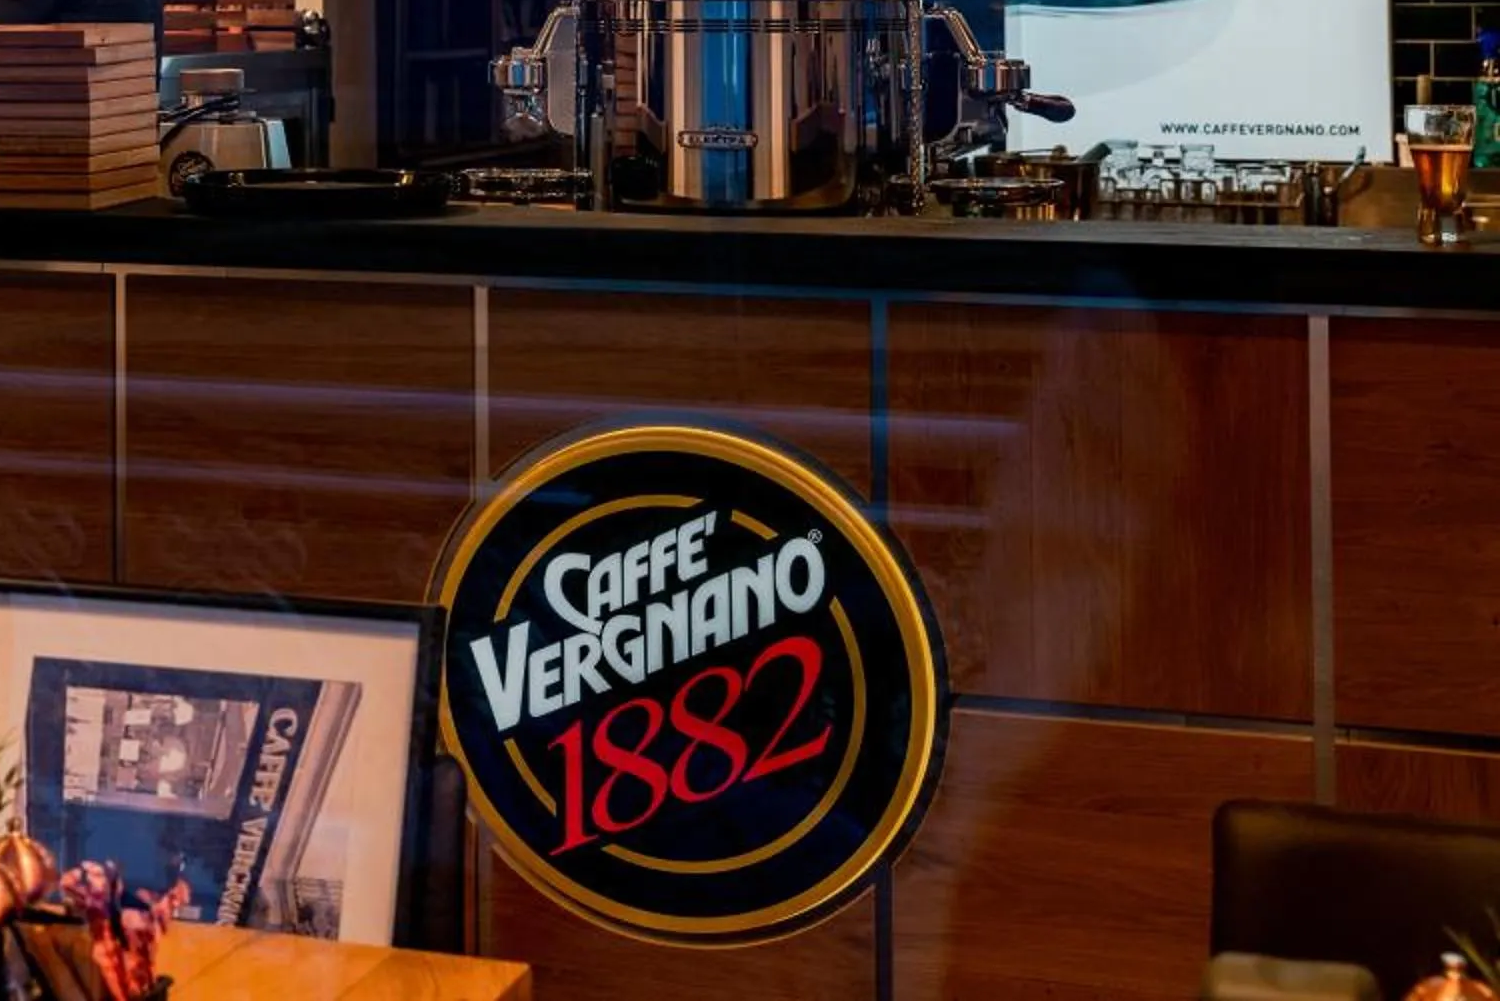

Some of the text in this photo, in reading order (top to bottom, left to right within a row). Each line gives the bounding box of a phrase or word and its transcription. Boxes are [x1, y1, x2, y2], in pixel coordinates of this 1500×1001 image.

[1160, 122, 1361, 136] WWW.CAFFEVERGNANO.COM
[469, 536, 826, 732] VERGNANO
[547, 635, 832, 856] 1882
